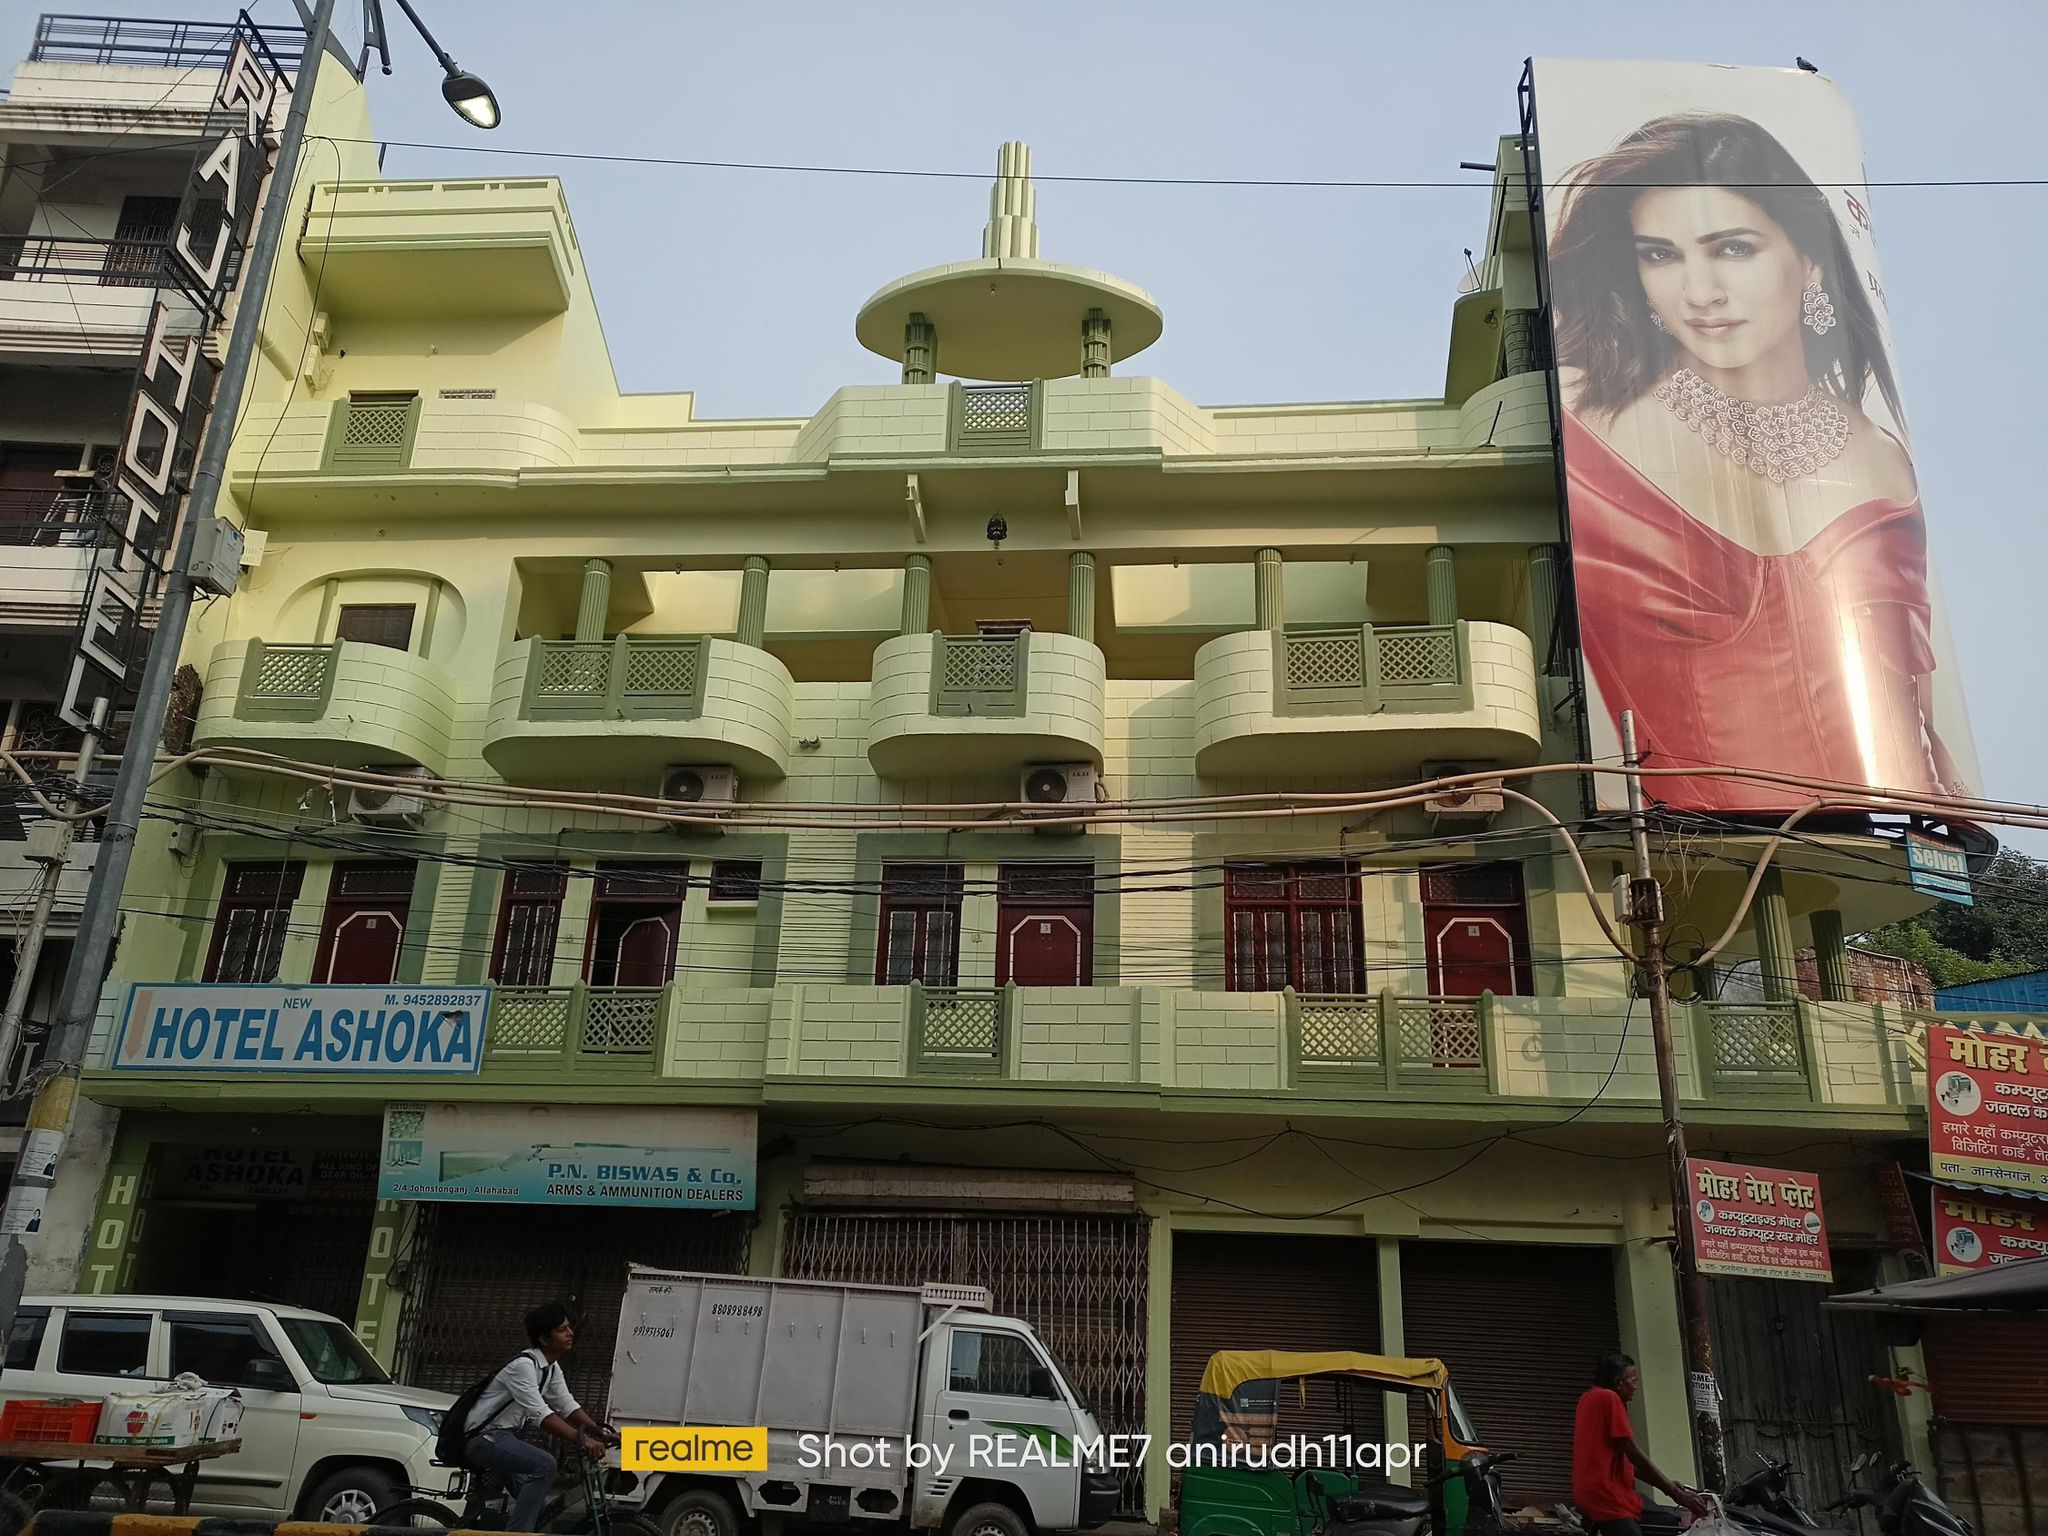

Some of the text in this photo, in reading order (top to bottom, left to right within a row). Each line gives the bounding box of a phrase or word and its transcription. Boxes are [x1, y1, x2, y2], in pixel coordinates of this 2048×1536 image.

[59, 37, 276, 732] RAJ HOTEL
[283, 998, 313, 1009] NEW
[384, 994, 481, 1007] M. 9452892837
[146, 1007, 473, 1063] HOTEL ASHOKA
[1946, 1030, 2029, 1075] मोहर
[1984, 1100, 2031, 1118] जनरल
[1942, 1121, 1970, 1135] हमारे
[1974, 1123, 1996, 1139] यहाँ
[1952, 1136, 1998, 1156] विजिटिंग
[184, 1163, 304, 1185] ASHOKA
[547, 1164, 743, 1185] P.N. BISWAS & Co.
[393, 1184, 408, 1194] 2/4
[474, 1185, 519, 1196] Allahabad
[546, 1184, 744, 1202] ARMS & AMMUNITION DEALERS
[1695, 1167, 1816, 1209] मोहर नेम प्लेट
[1777, 1213, 1803, 1229] मोहर
[1703, 1223, 1737, 1237] जनरल
[1795, 1230, 1819, 1245] मोहर
[712, 1303, 763, 1317] 8808988498
